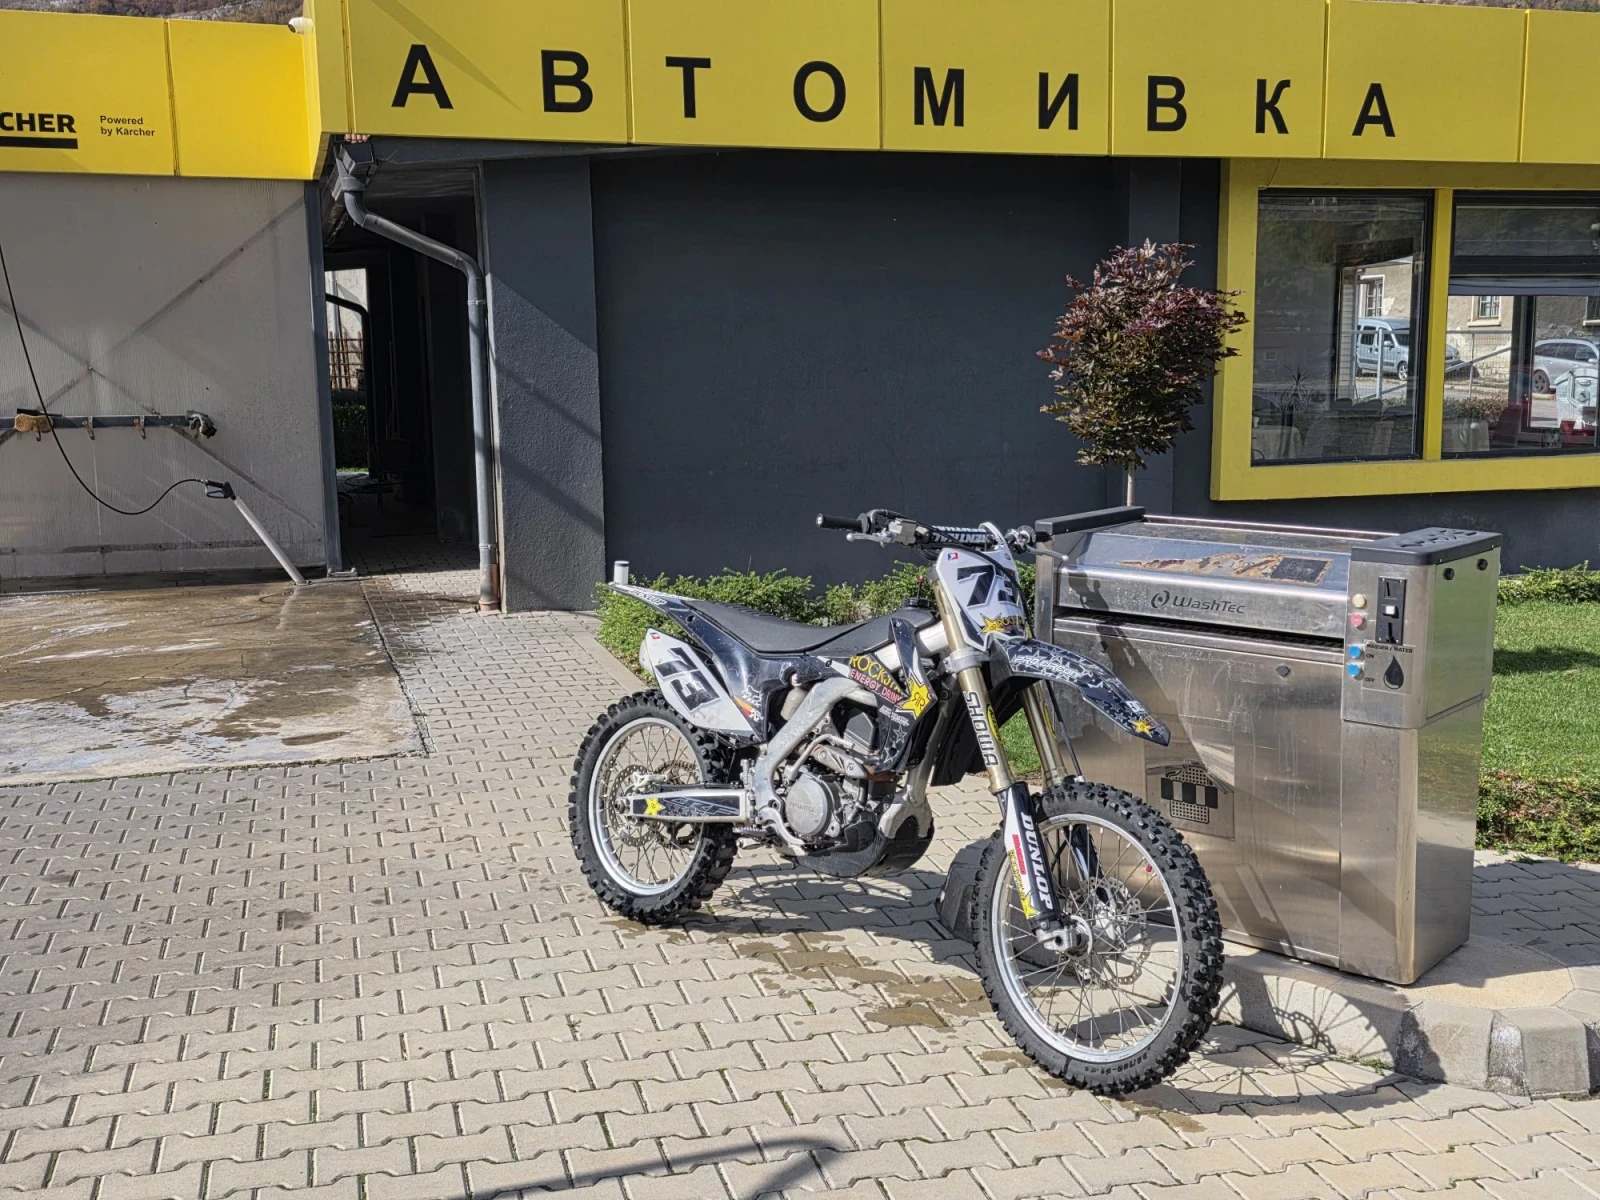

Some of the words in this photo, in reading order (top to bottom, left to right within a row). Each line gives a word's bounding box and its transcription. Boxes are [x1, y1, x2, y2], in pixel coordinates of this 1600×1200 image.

[100, 115, 144, 125] Powered
[101, 127, 112, 137] by
[1394, 646, 1413, 654] WATER
[1037, 658, 1084, 679] CIRCUIT
[850, 668, 881, 692] ENERGY
[962, 690, 999, 767] SHOWA
[1020, 811, 1054, 910] DUNLOP
